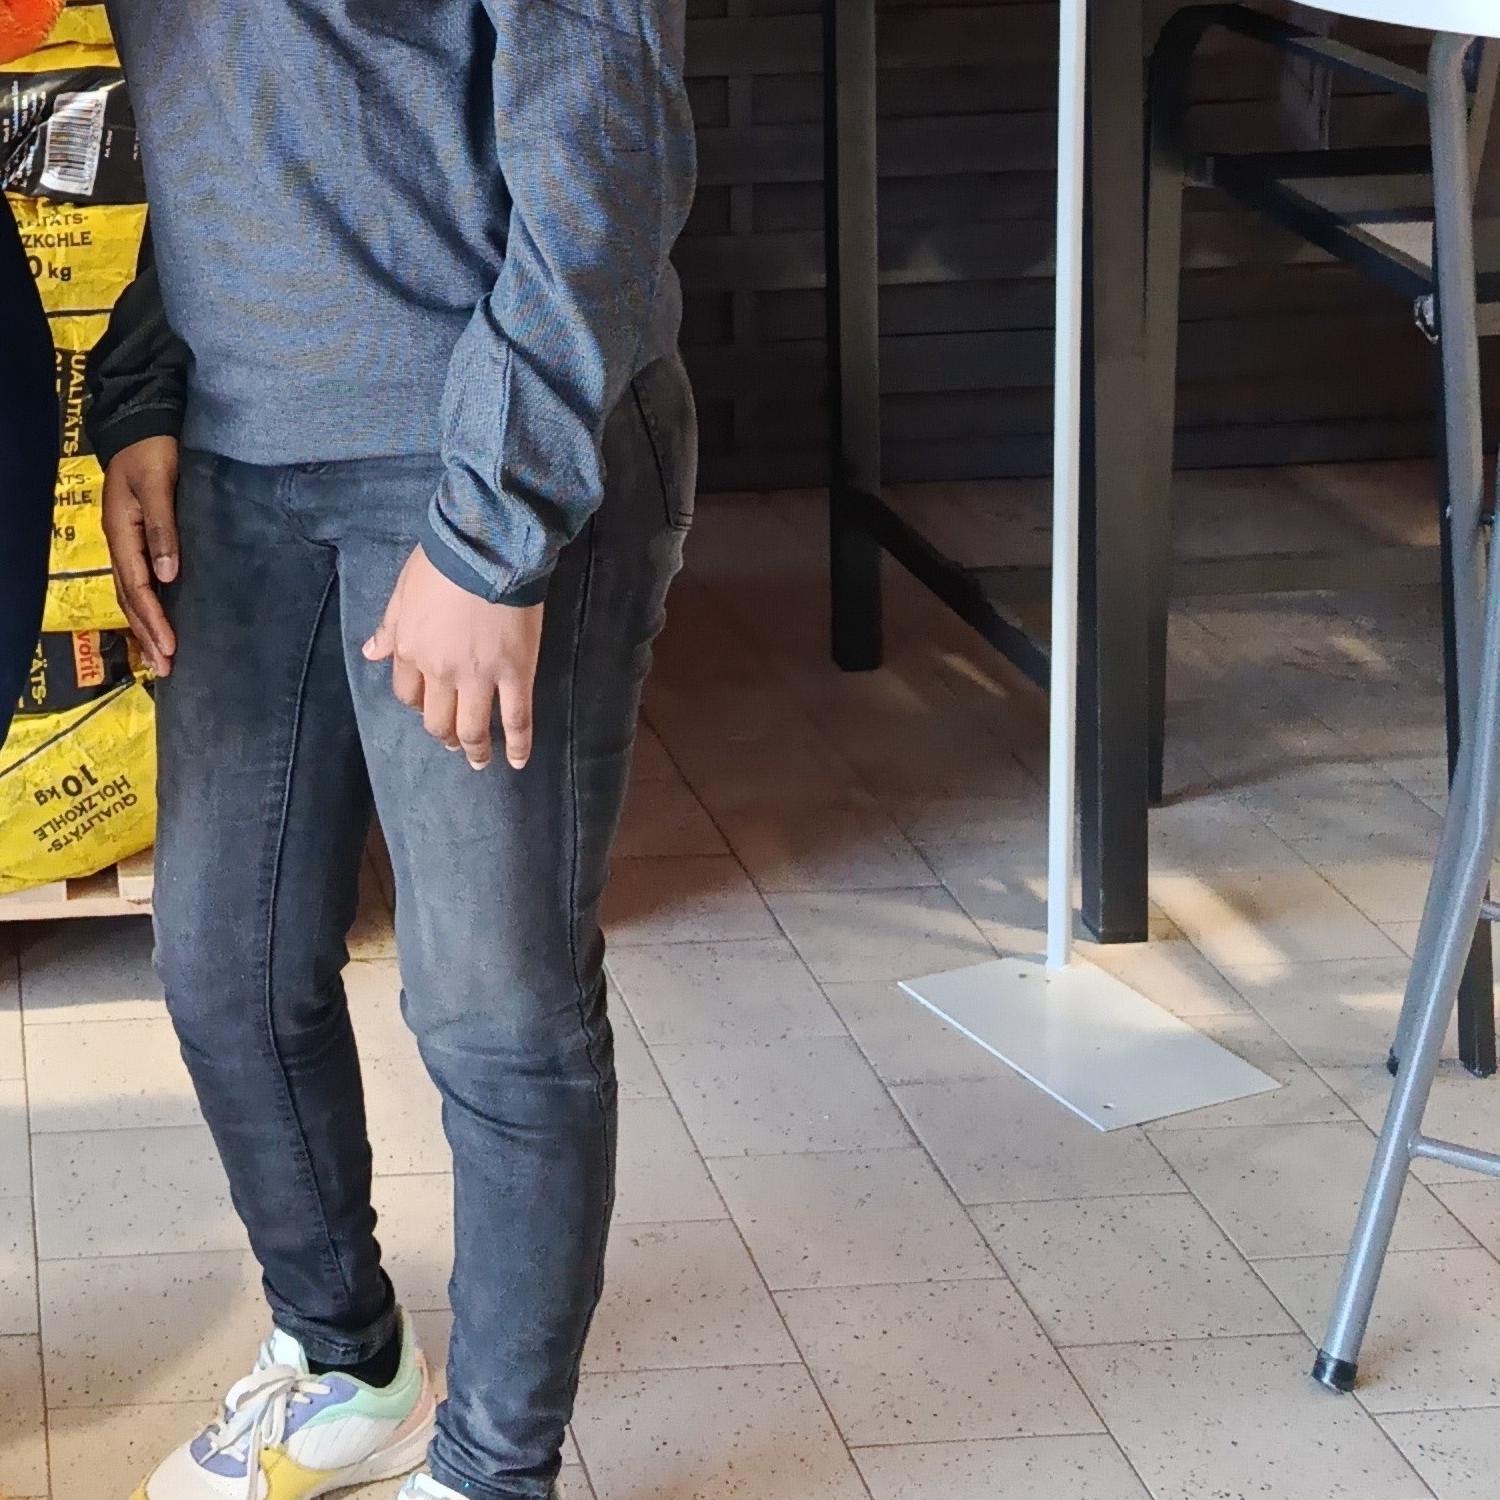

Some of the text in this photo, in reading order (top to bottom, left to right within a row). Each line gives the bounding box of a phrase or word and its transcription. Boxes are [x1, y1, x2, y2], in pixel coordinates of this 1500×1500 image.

[23, 231, 93, 249] ZKOHLE
[48, 264, 72, 282] kg
[63, 351, 87, 457] UALITÄTS-
[75, 631, 98, 680] vorit
[33, 774, 132, 842] HOLZKOHLE
[34, 763, 100, 807] 10 kg
[47, 792, 138, 853] QUALITÄTS-
